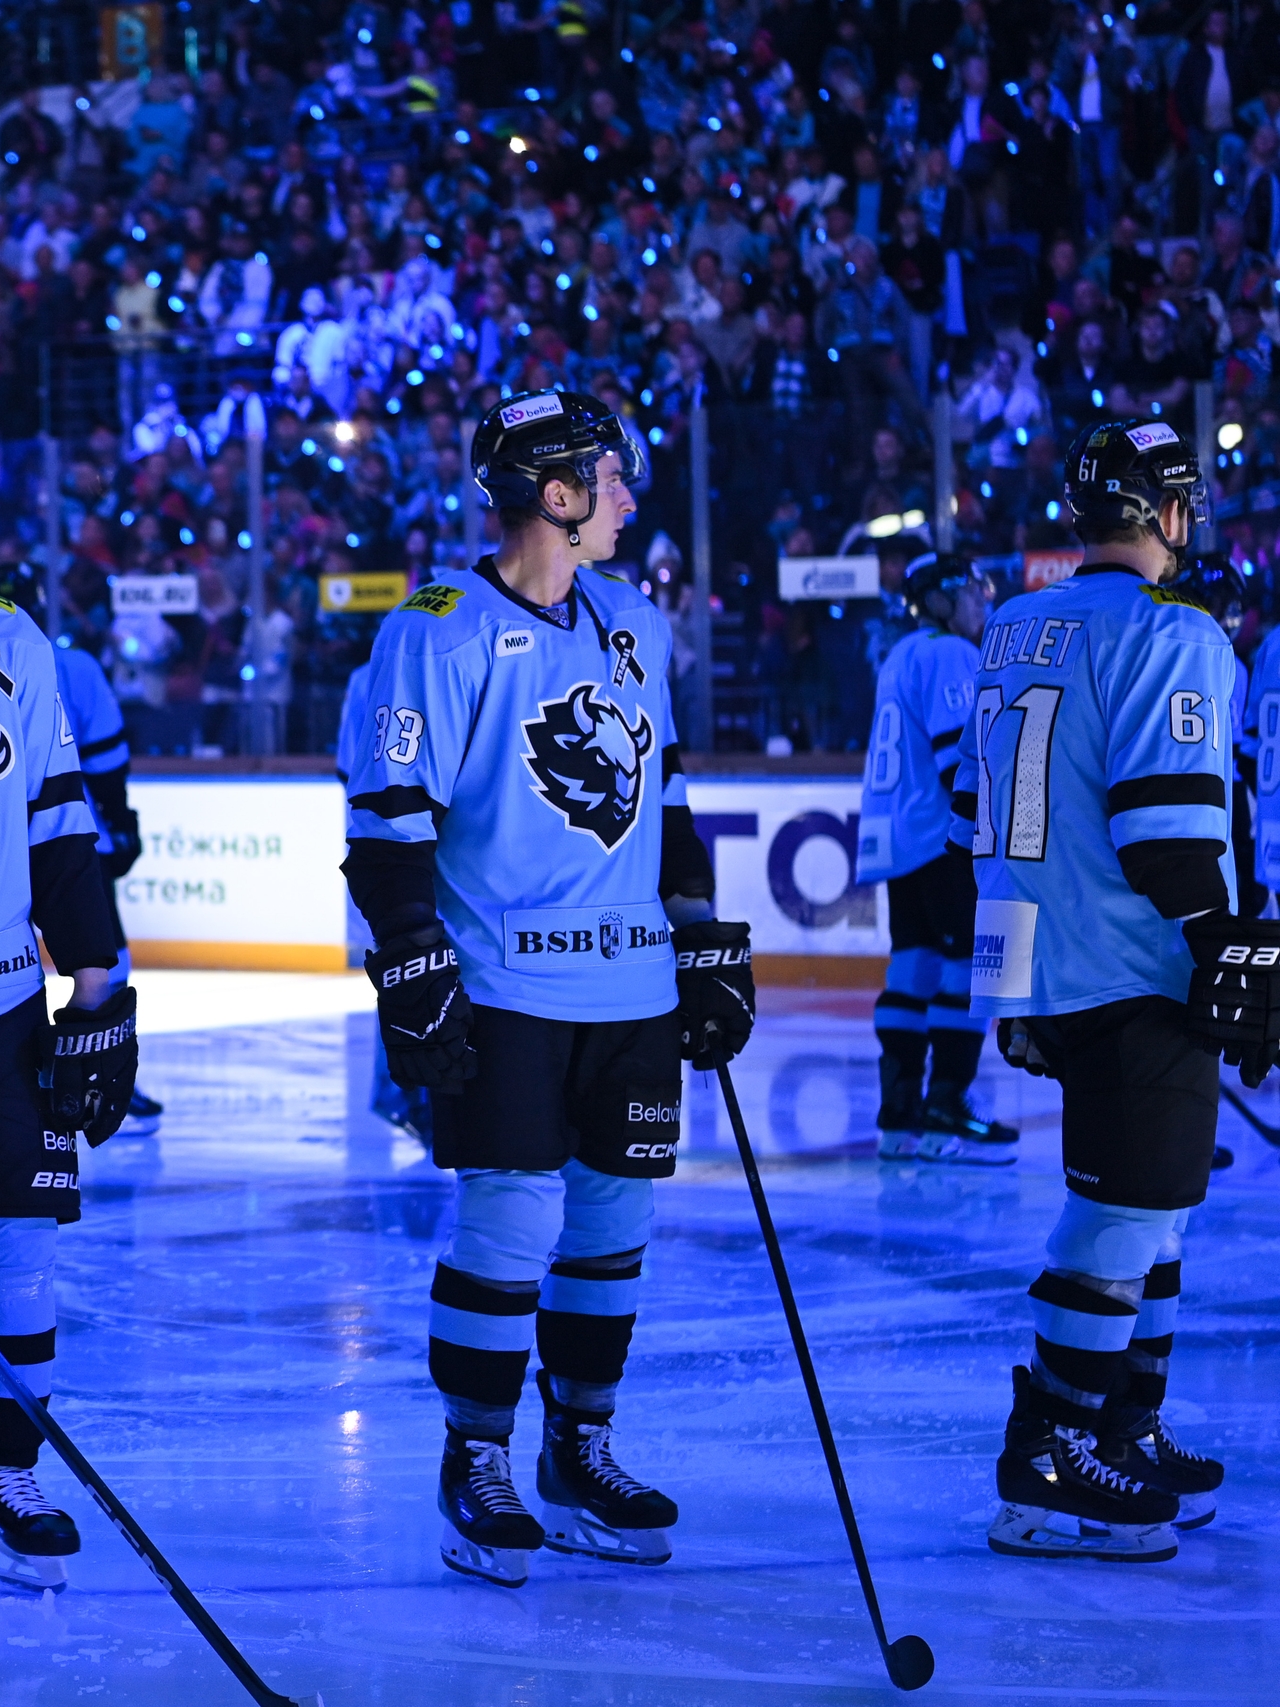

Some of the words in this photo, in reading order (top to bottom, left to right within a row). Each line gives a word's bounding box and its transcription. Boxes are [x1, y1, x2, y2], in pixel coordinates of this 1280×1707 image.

[526, 403, 560, 418] belbet
[532, 443, 566, 455] CCM
[1078, 459, 1098, 482] 61
[1163, 464, 1187, 477] CCM
[405, 598, 449, 613] LINE
[504, 636, 529, 649] МИР
[1170, 689, 1219, 751] 61
[374, 704, 426, 767] 33
[513, 930, 594, 954] BSB
